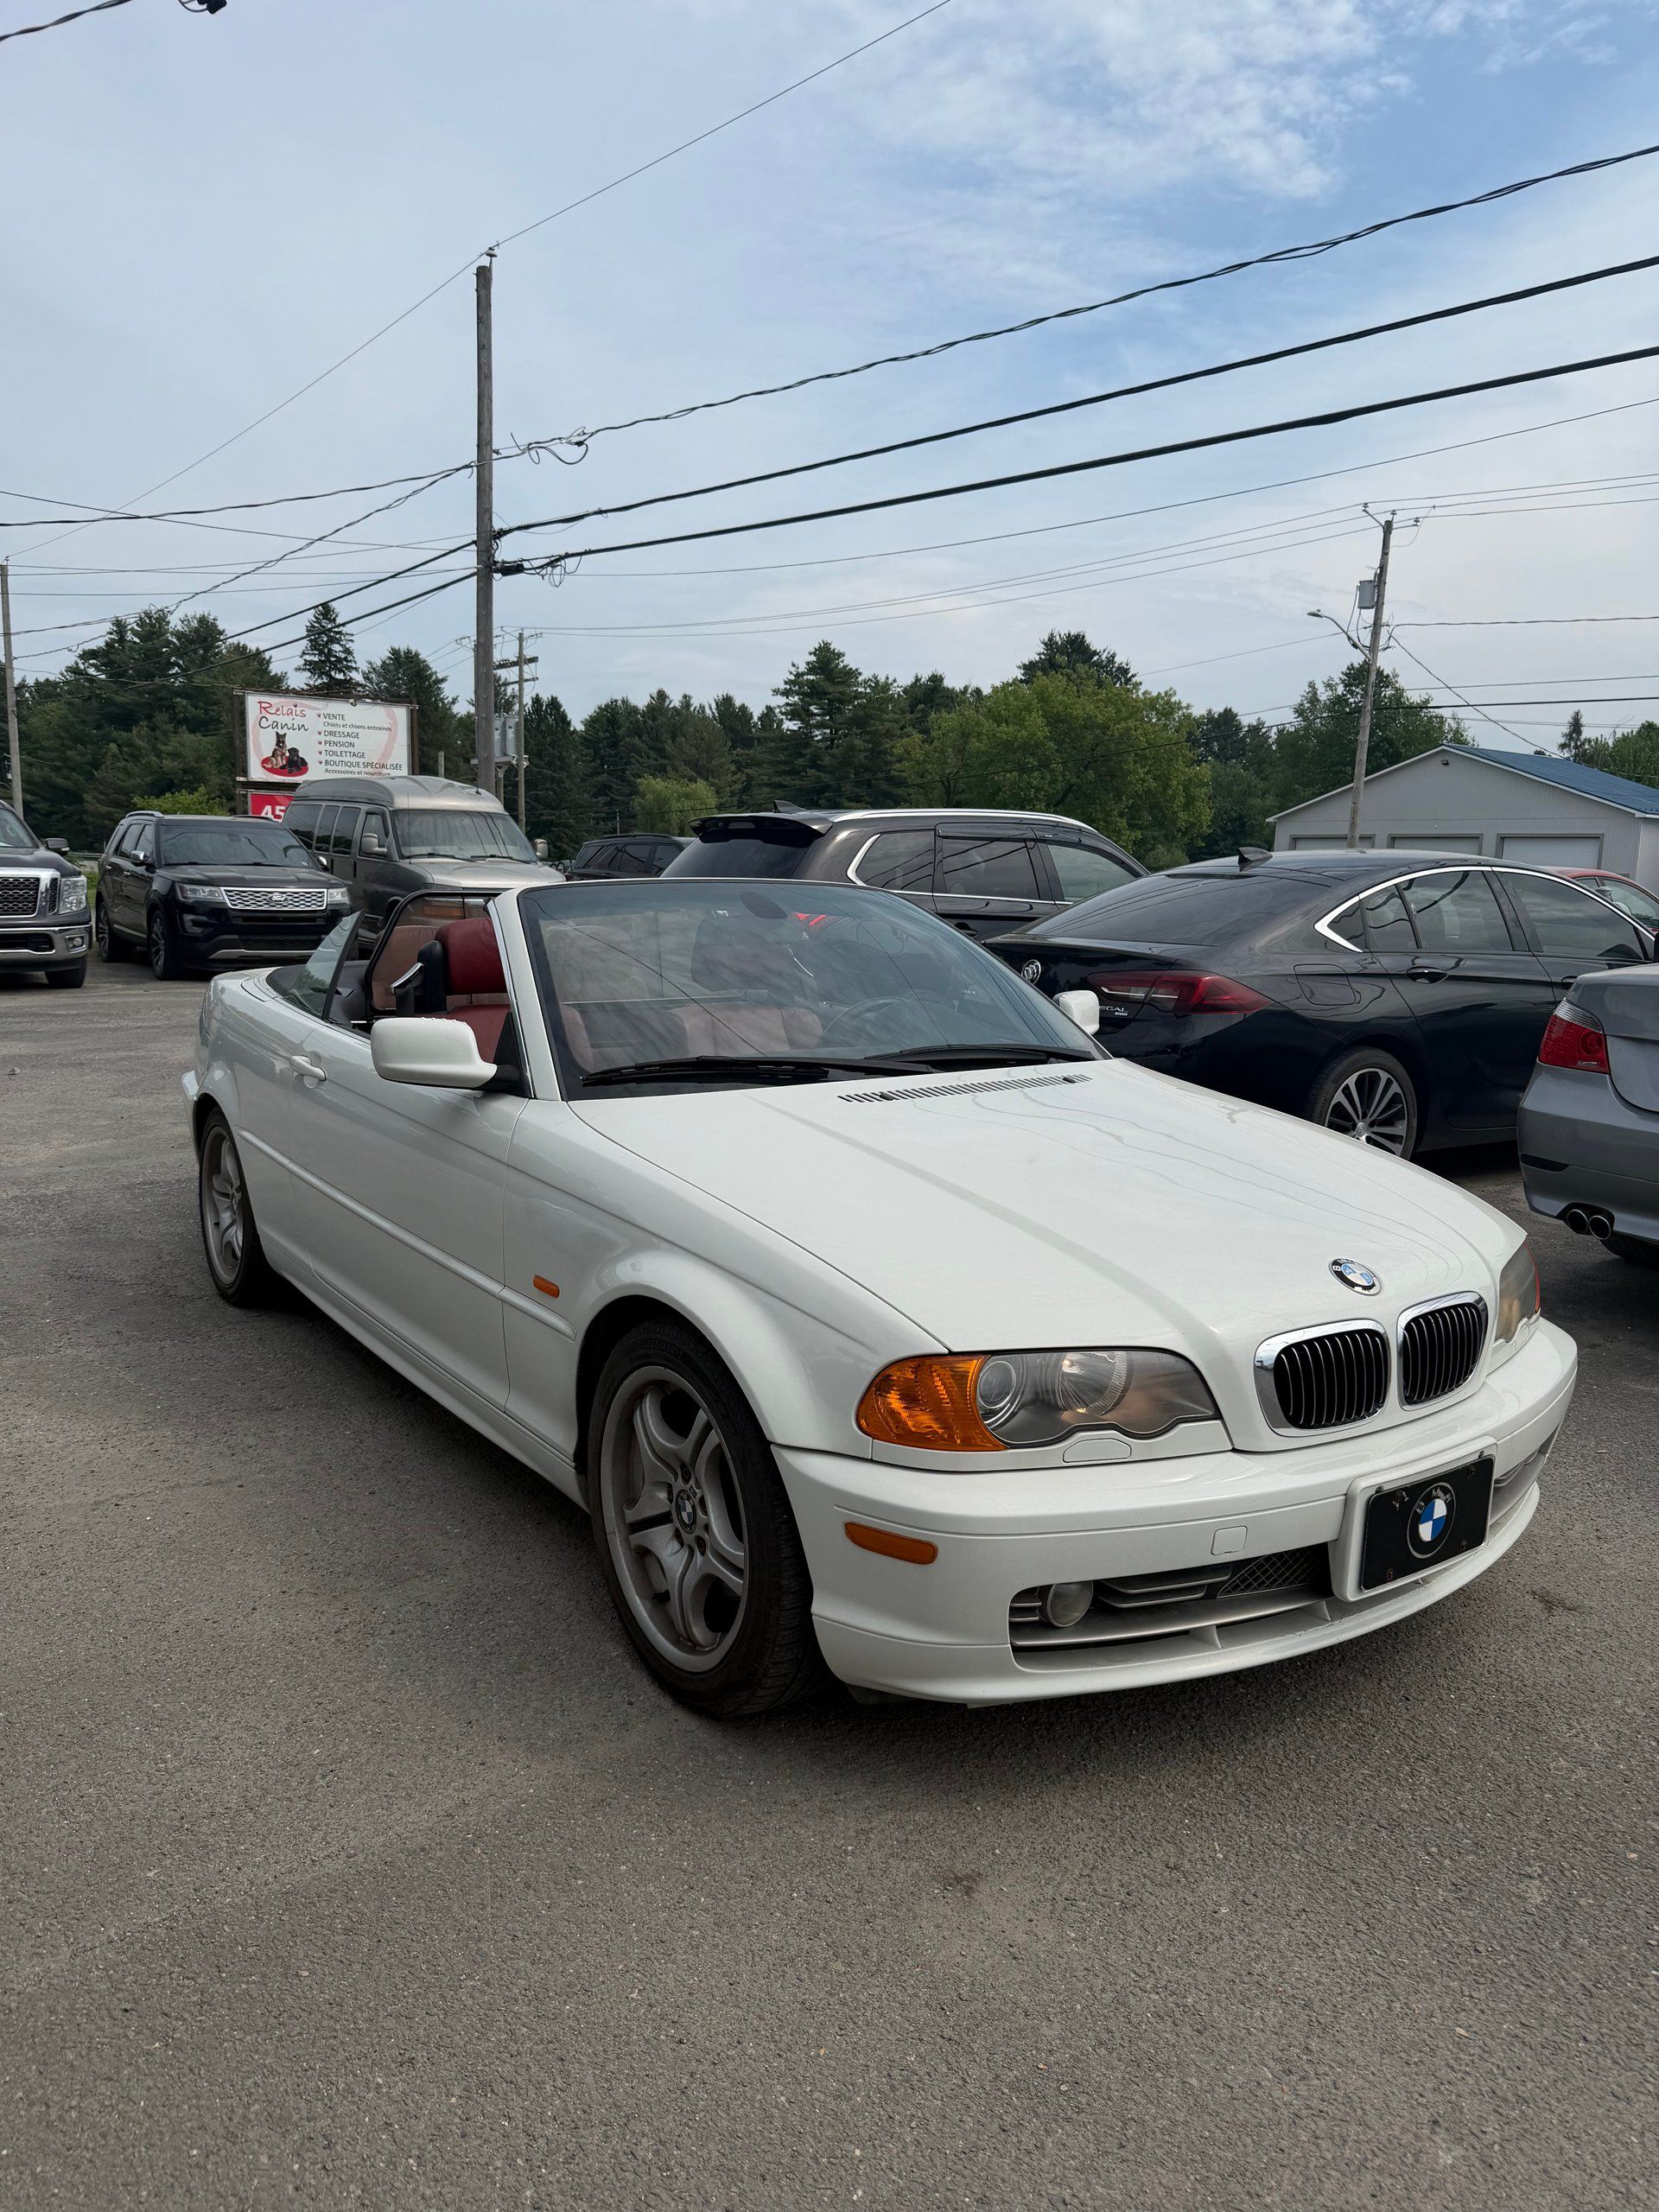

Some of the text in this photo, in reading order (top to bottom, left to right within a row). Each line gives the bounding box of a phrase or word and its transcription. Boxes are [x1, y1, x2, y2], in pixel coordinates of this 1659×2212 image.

[257, 701, 306, 718] Relais
[322, 713, 346, 721] VENTE
[258, 715, 308, 731] Canin
[323, 729, 360, 740] DRESSAGE
[324, 740, 355, 748] PENSION
[324, 749, 365, 759] TOILETTAGE
[324, 760, 360, 768] BOUTIQUE
[324, 767, 356, 776] Accessoires
[1416, 1486, 1452, 1515] BMW
